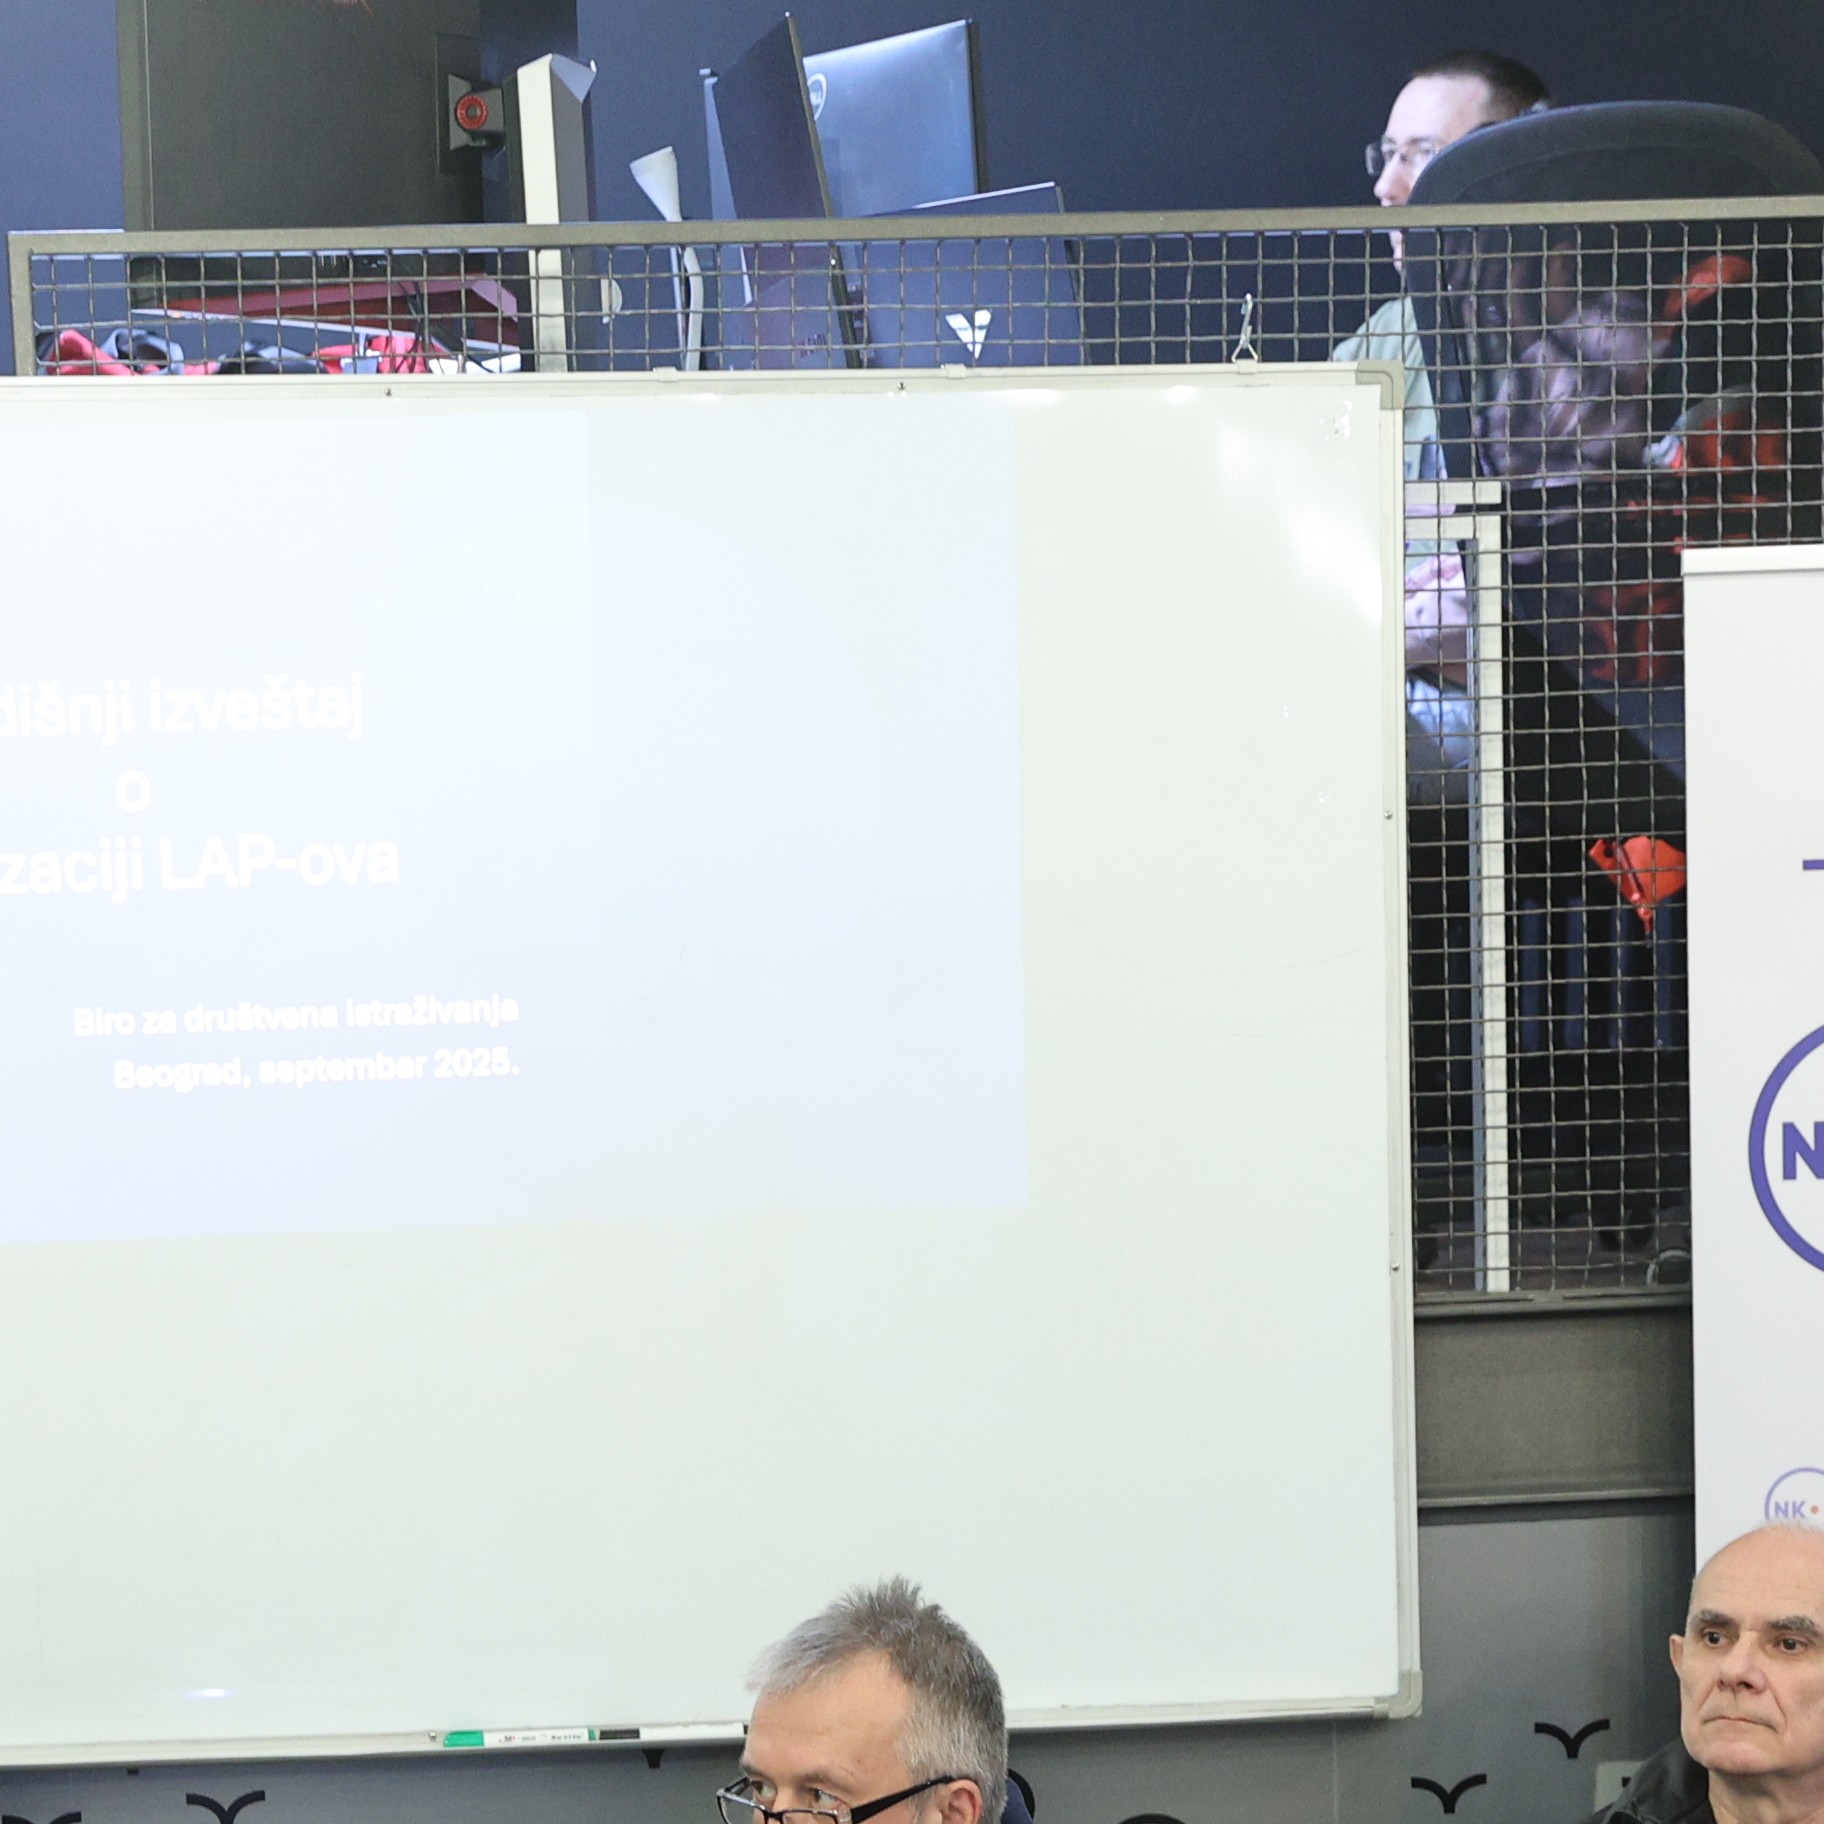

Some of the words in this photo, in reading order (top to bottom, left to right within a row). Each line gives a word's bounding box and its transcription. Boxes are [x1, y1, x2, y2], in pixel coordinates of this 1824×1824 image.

[148, 671, 366, 741] izveštaj
[114, 767, 153, 813] o
[158, 833, 402, 893] LAP-ova
[73, 1006, 135, 1038] Biro
[142, 1008, 177, 1035] za
[114, 1058, 252, 1094] Beograd,
[259, 1052, 427, 1088] septembar
[434, 1047, 520, 1078] 2025.
